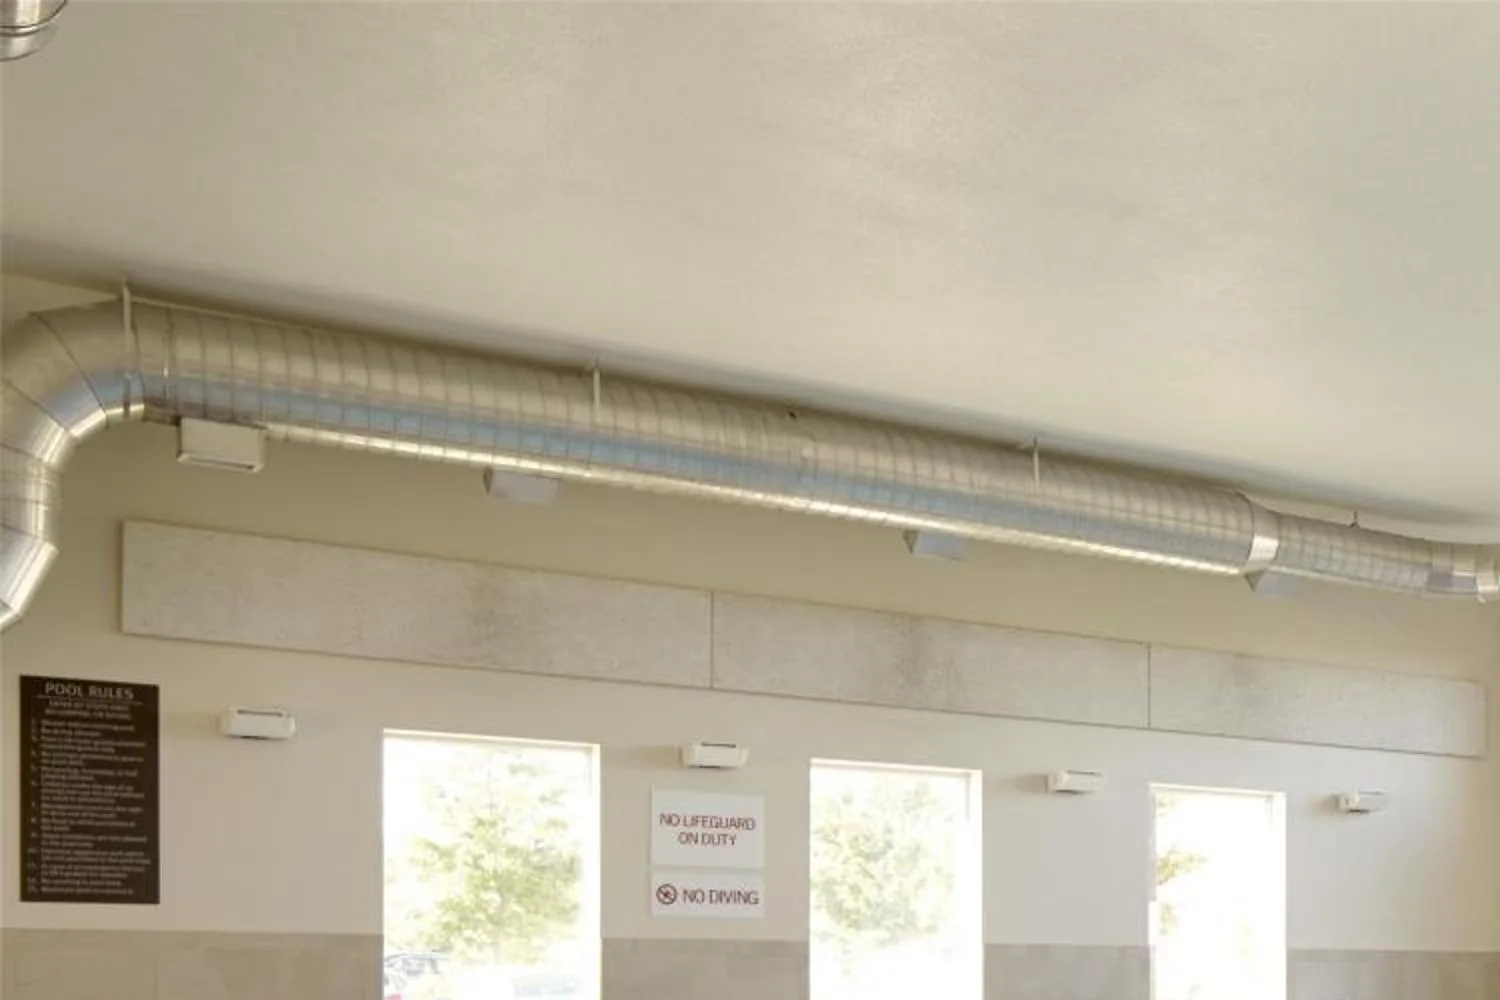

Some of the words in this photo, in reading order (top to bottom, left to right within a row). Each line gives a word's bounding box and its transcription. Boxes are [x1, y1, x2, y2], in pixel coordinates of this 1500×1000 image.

[45, 682, 83, 698] POOL
[88, 685, 134, 700] RULES
[659, 812, 680, 828] NO
[682, 815, 756, 831] LIFEGUARD
[678, 831, 699, 845] ON
[701, 833, 737, 846] DUTY
[682, 888, 705, 905] NO
[709, 889, 760, 905] DIVING
